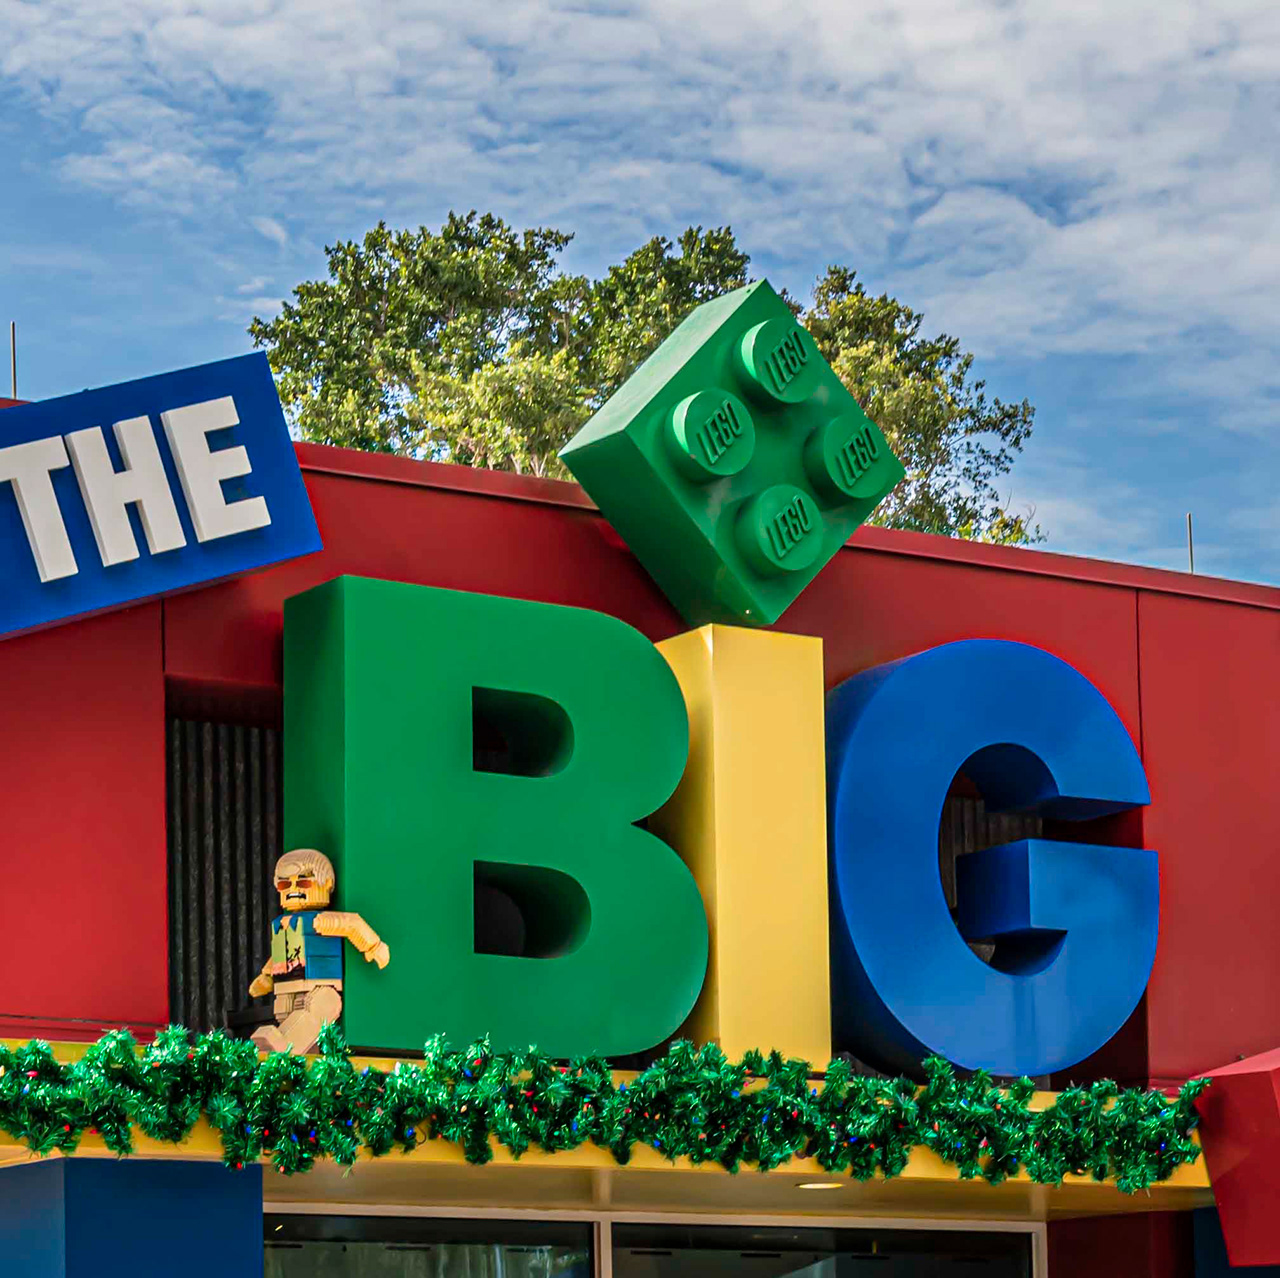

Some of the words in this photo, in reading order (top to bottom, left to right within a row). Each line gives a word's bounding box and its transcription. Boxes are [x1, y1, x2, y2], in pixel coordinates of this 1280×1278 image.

[763, 329, 808, 394] LEGO
[696, 400, 744, 466] LEGO
[834, 424, 880, 488] LEGO
[765, 495, 813, 559] LEGO
[284, 575, 1159, 1076] BIG
